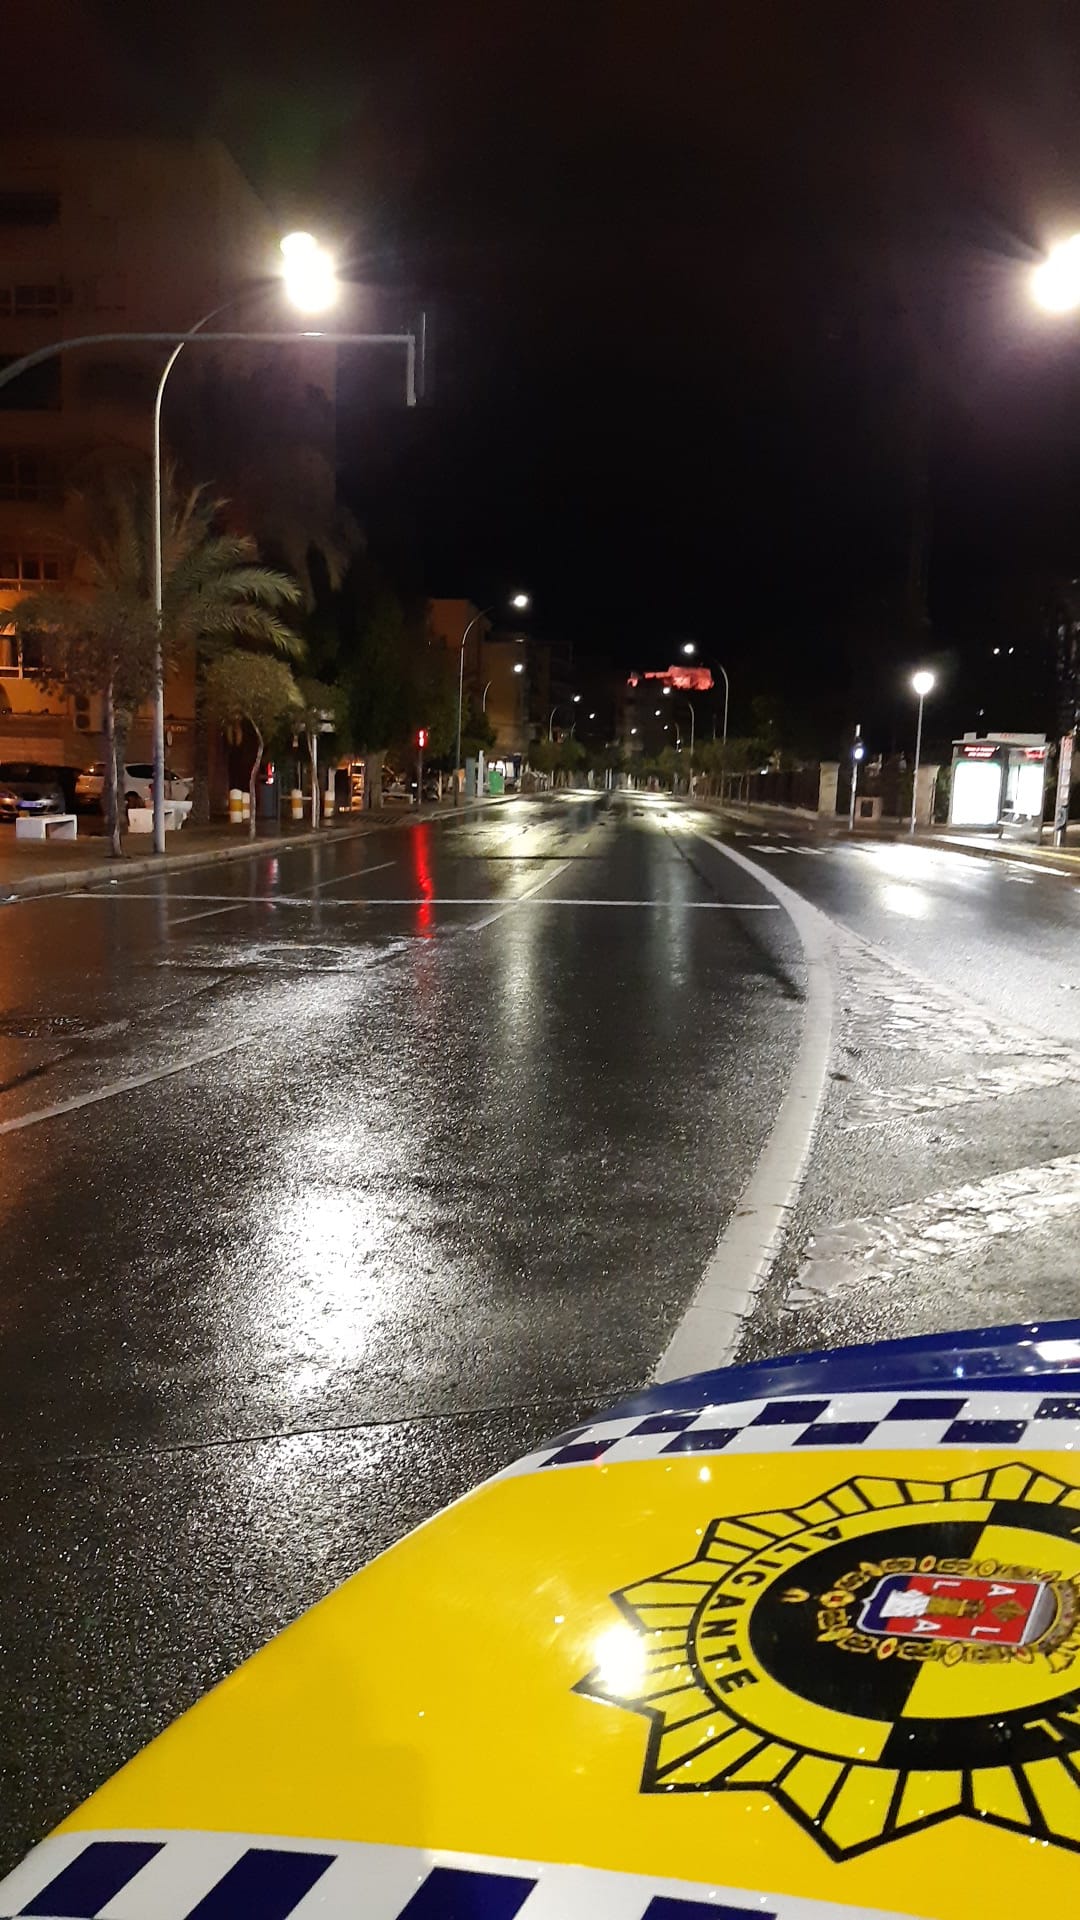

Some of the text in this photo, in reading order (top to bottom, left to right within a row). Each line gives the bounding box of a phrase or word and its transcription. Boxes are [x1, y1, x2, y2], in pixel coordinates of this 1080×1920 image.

[701, 1525, 843, 1694] ALICANTE
[911, 1580, 962, 1633] L A
[970, 1583, 1017, 1636] A L
